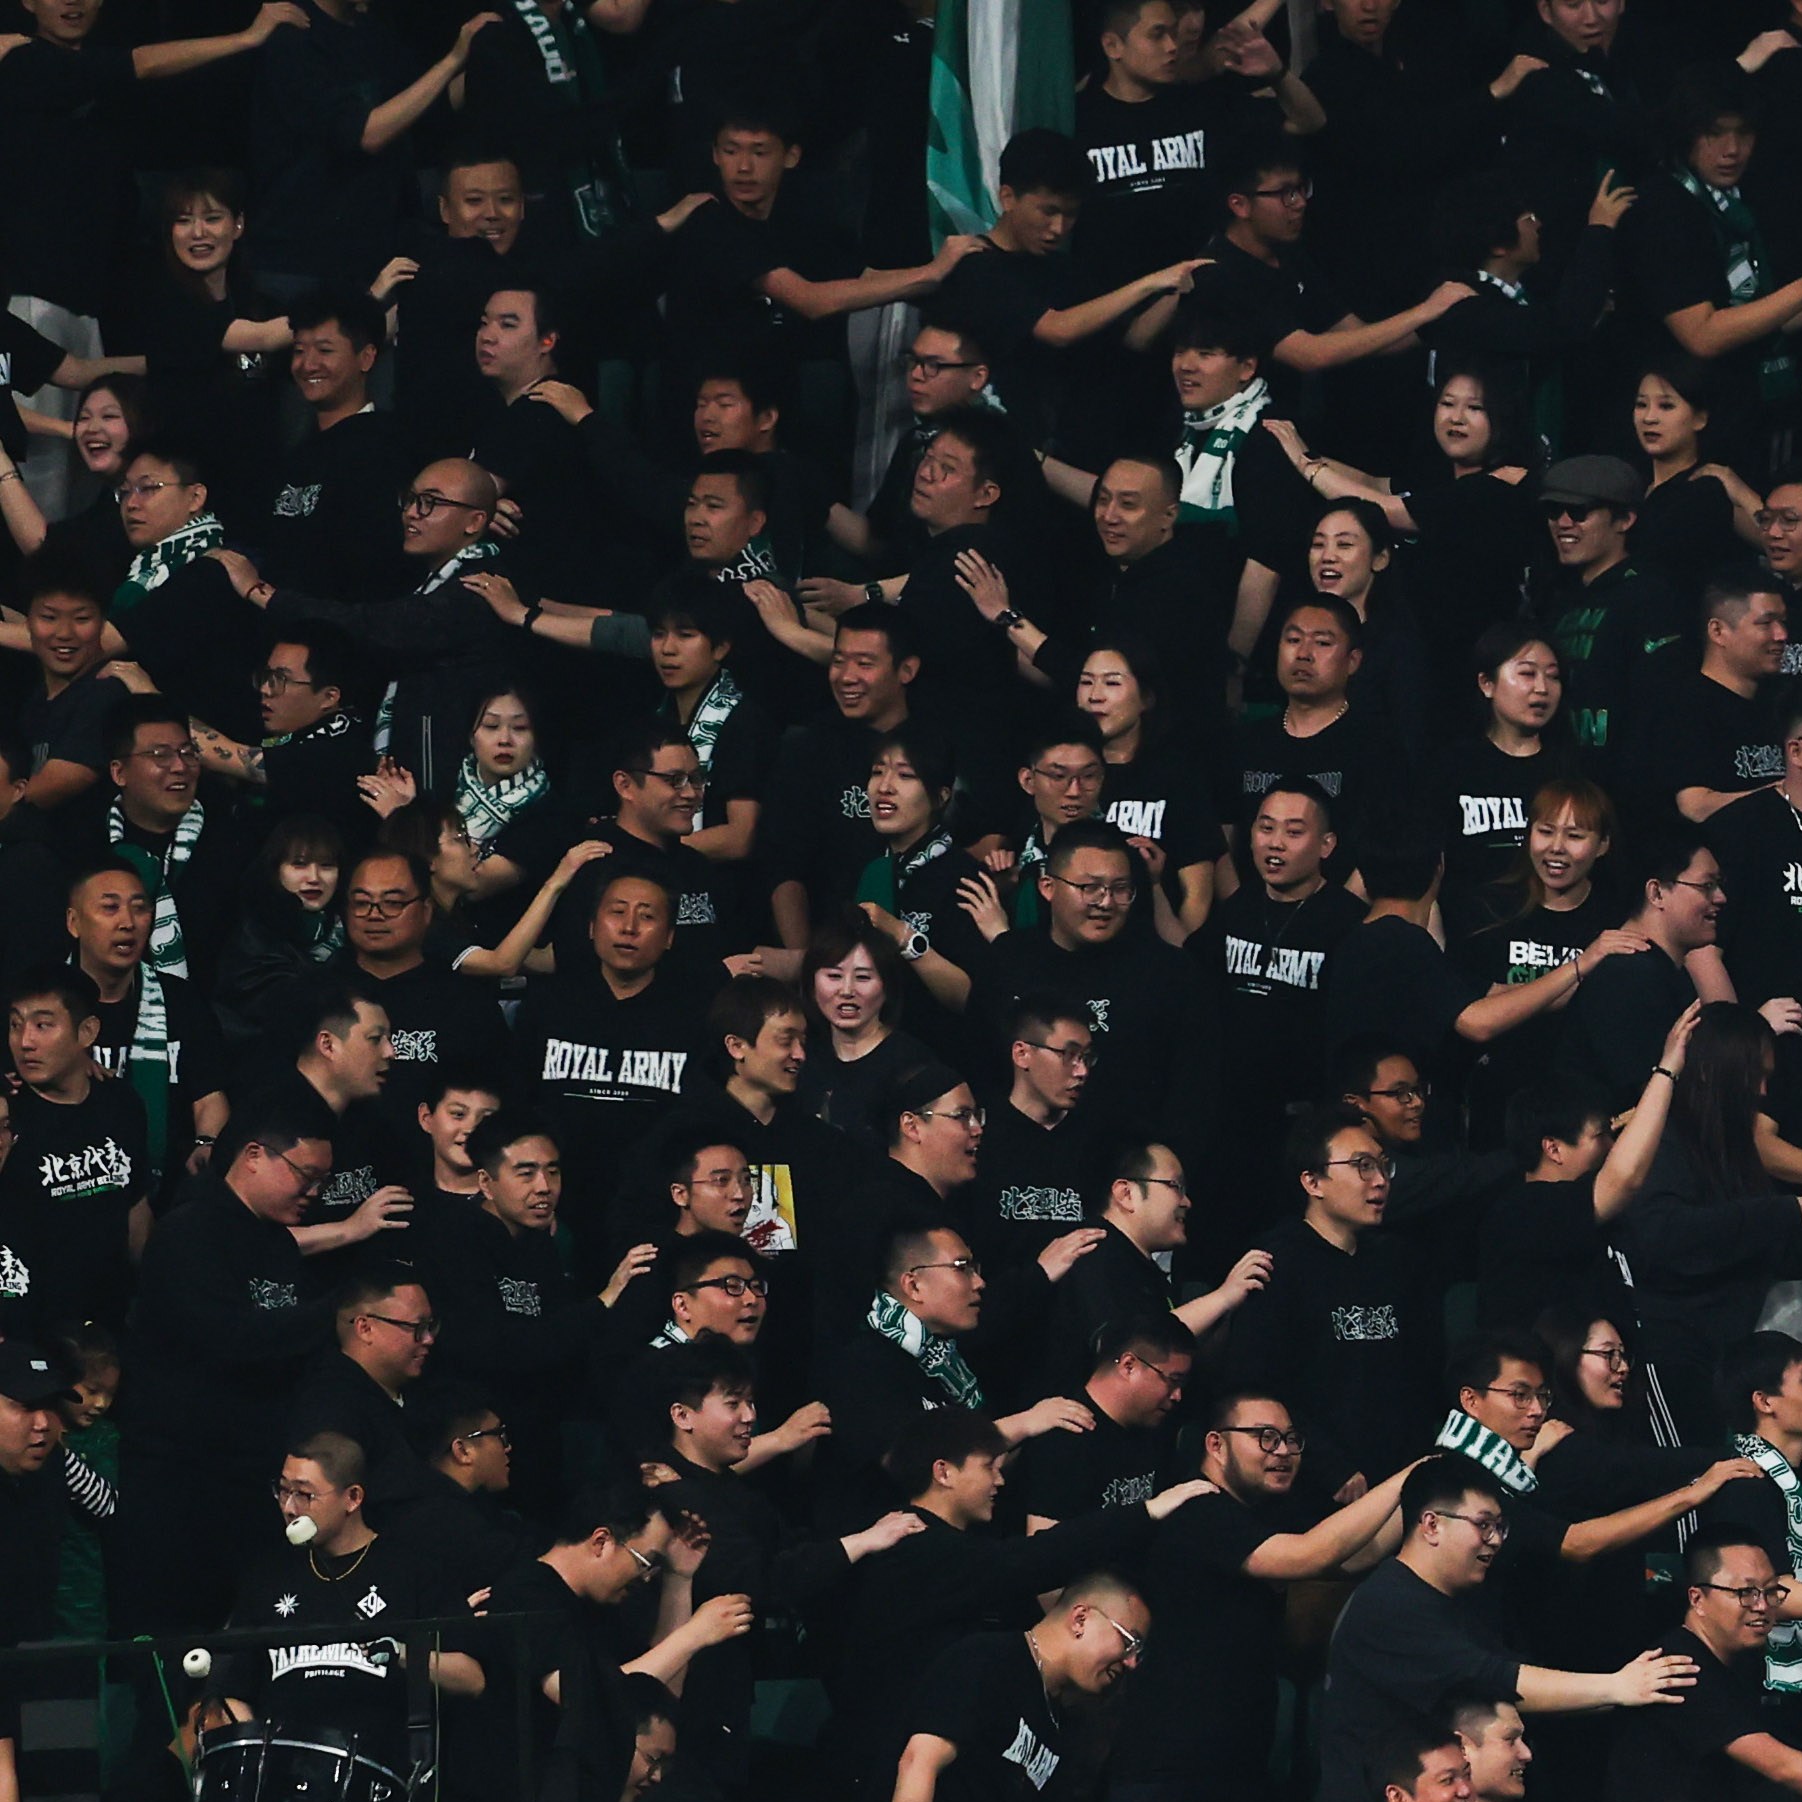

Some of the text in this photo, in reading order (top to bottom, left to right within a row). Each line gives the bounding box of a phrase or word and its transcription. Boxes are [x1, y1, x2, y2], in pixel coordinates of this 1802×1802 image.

[1152, 130, 1205, 171] ARMY
[1459, 795, 1529, 837] ROYAL
[1264, 947, 1326, 991] ARMY
[543, 1037, 688, 1094] ROYAL ARMY
